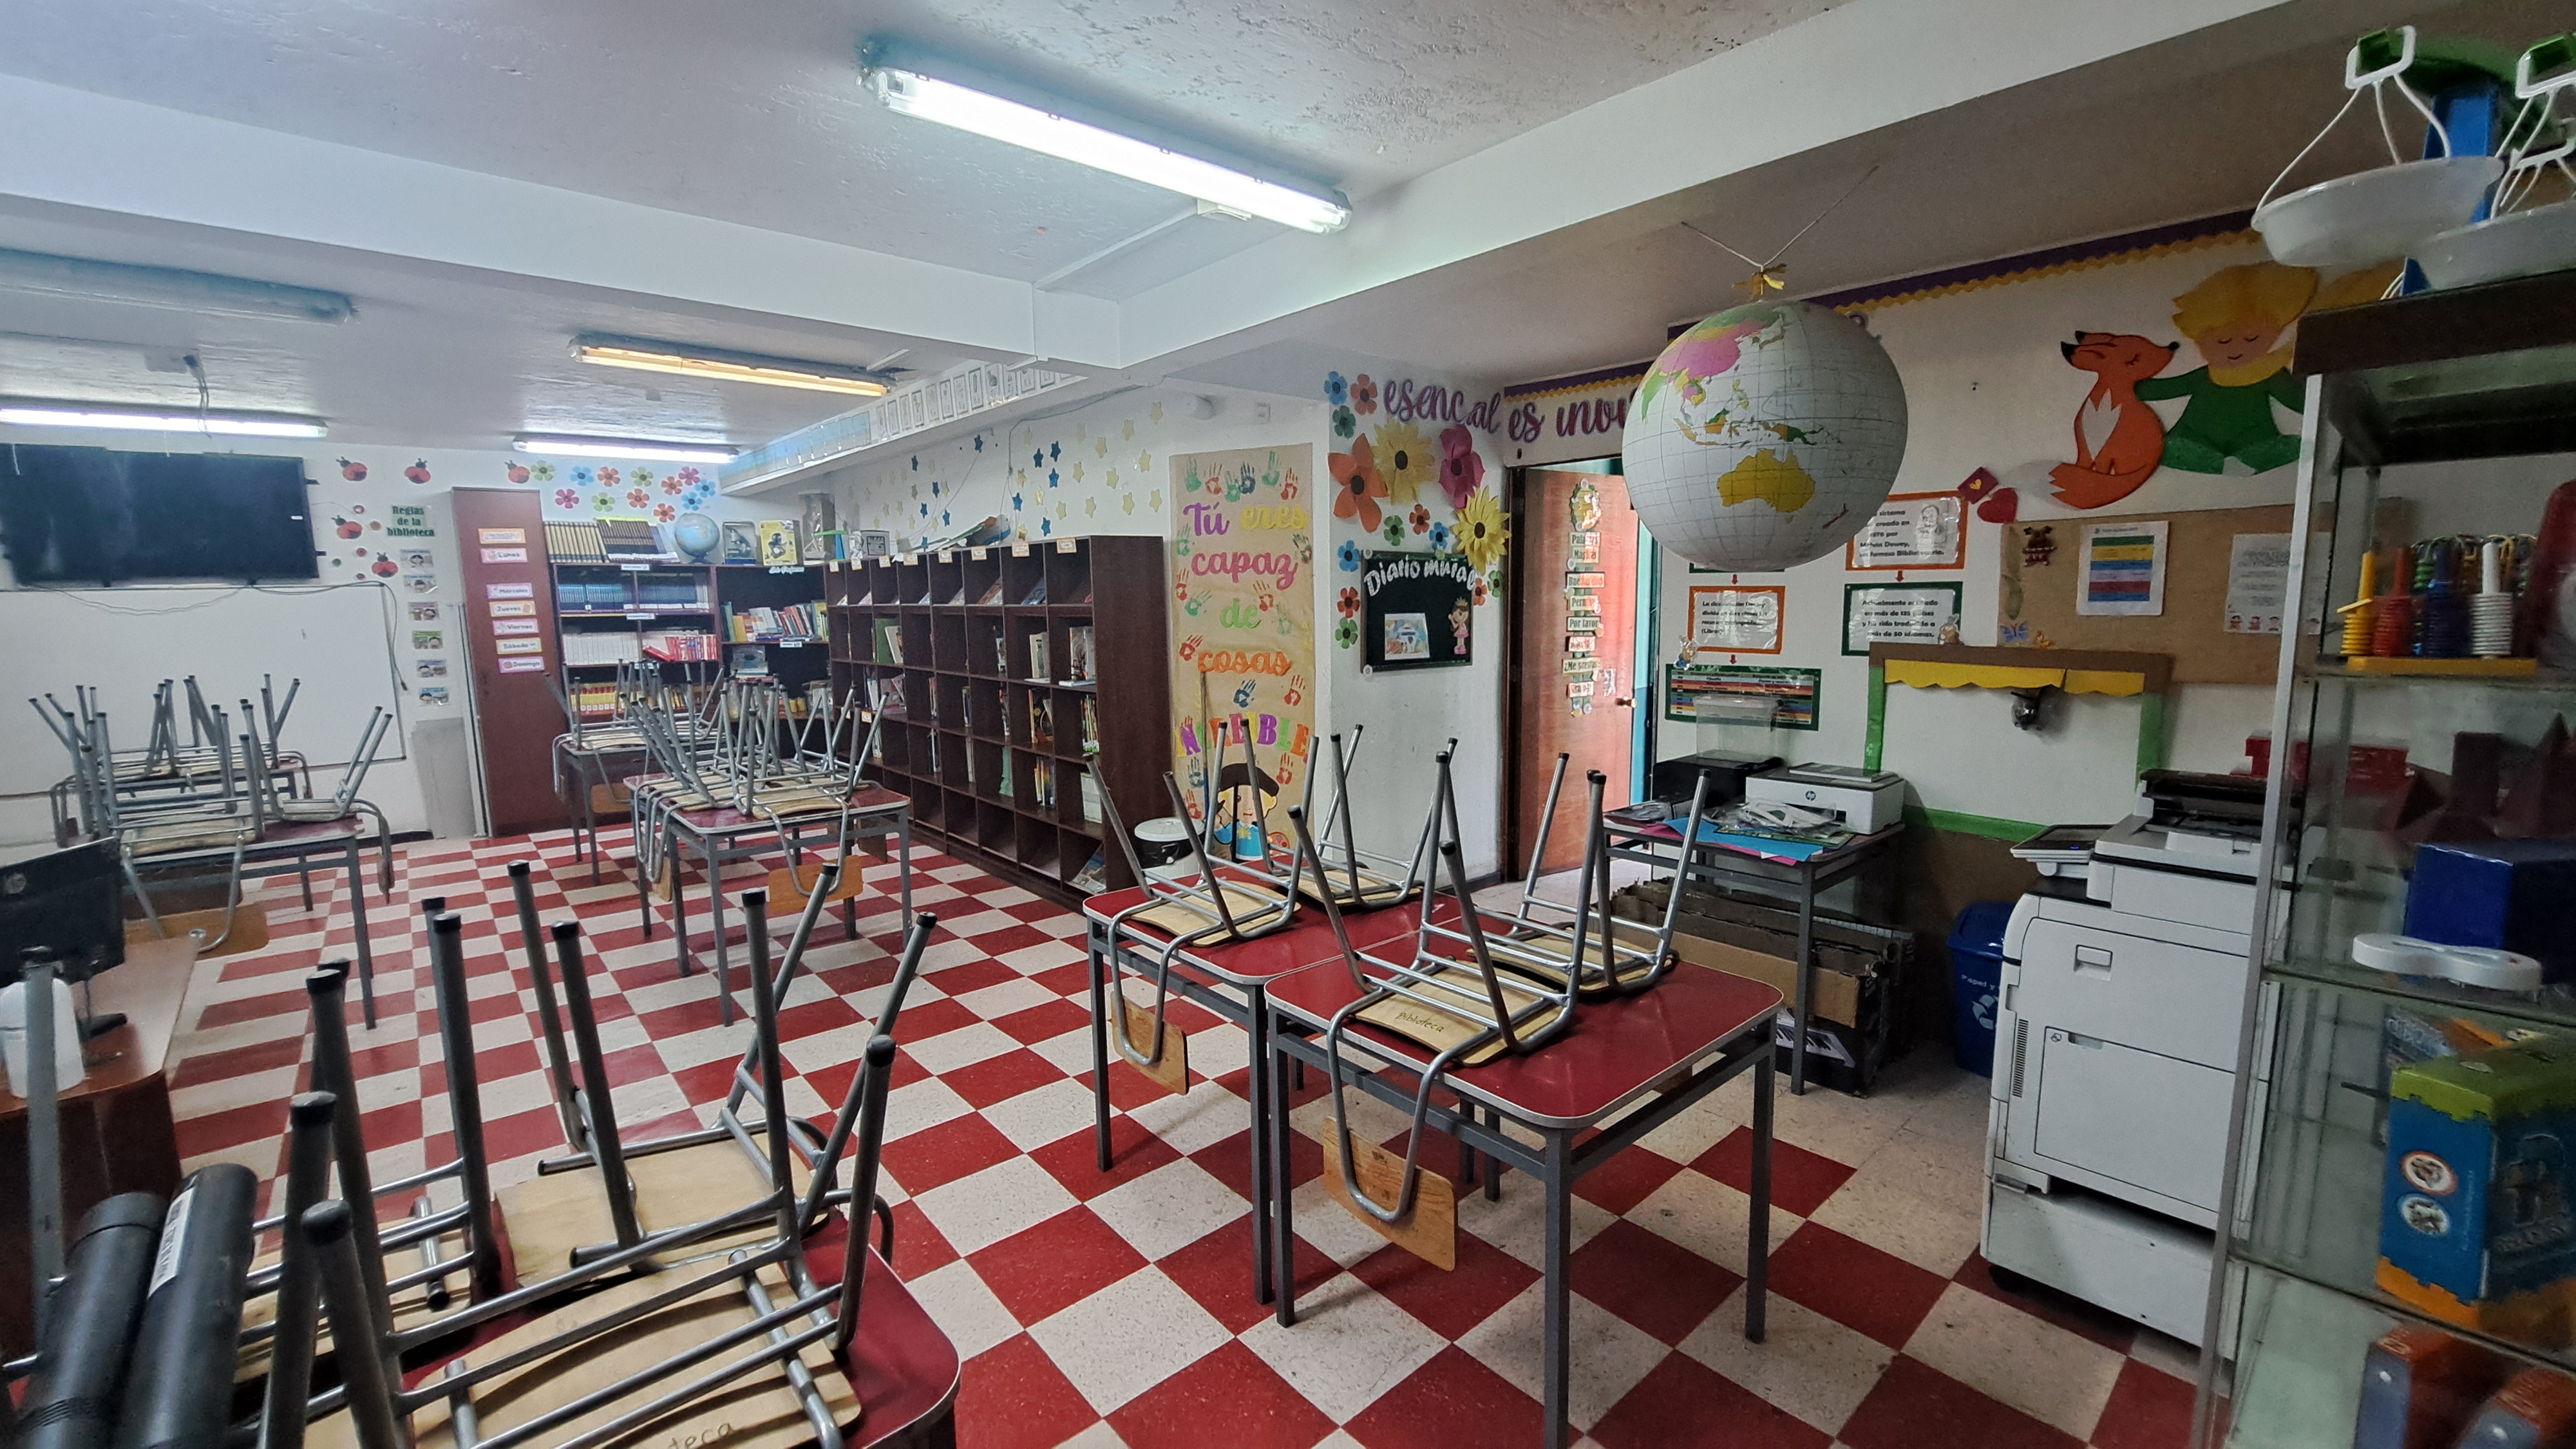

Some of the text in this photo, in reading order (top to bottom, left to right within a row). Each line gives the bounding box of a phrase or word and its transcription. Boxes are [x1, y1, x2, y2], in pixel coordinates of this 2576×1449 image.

[1509, 402, 1545, 442] es
[1556, 386, 1639, 437] invi
[387, 527, 435, 536] biblioteca
[397, 517, 421, 526] de la
[1183, 502, 1309, 536] Tú eres
[1572, 535, 1600, 545] Pala
[1191, 552, 1298, 590] capaz
[1364, 554, 1476, 596] Diario mural
[1220, 598, 1262, 629] de
[1569, 618, 1580, 628] Por
[1198, 650, 1292, 677] cosas
[1175, 712, 1309, 762] INCREIBLE
[1961, 974, 1987, 988] Papel
[1395, 1012, 1444, 1033] Biblioteca
